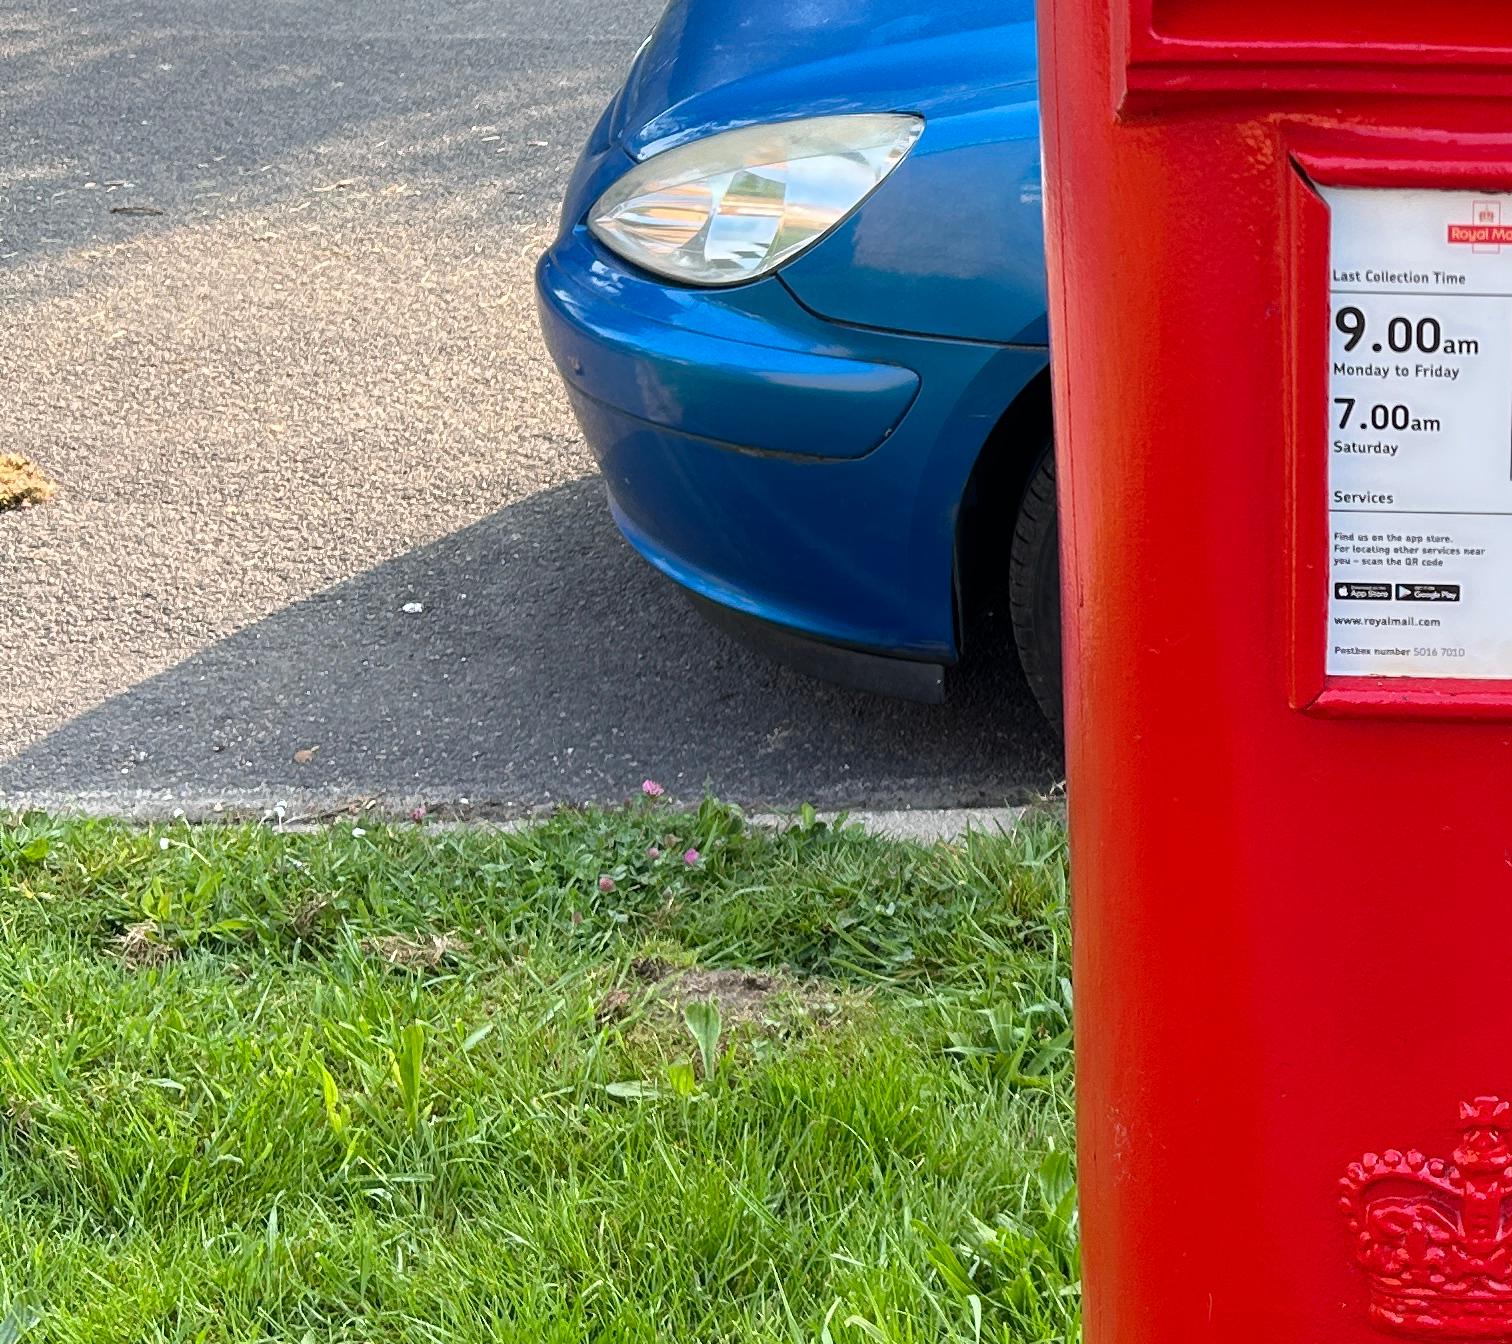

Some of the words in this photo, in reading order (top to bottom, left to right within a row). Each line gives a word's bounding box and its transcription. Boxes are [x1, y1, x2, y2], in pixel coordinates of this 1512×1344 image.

[1451, 226, 1490, 243] Royal
[1333, 269, 1361, 283] Last
[1365, 270, 1429, 284] Collection
[1433, 271, 1466, 286] Time
[1335, 307, 1479, 355] 9.00am
[1333, 363, 1390, 380] Monday
[1395, 365, 1409, 377] to
[1415, 364, 1460, 380] Friday
[1334, 398, 1441, 432] 7.00am
[1333, 439, 1399, 457] Saturday
[1334, 490, 1394, 504] Services
[1334, 532, 1354, 542] Find
[1357, 534, 1369, 542] us
[1371, 534, 1384, 542] on
[1386, 533, 1403, 542] the
[1405, 535, 1423, 544] app
[1334, 544, 1350, 553] For
[1352, 545, 1391, 556] locating
[1393, 545, 1420, 555] other
[1422, 546, 1461, 556] services
[1463, 548, 1486, 556] near
[1333, 558, 1351, 567] you
[1361, 558, 1384, 566] scan
[1386, 557, 1402, 566] the
[1405, 557, 1418, 567] QR
[1421, 558, 1444, 567] code
[1334, 616, 1441, 627] www.royalmail.com
[1334, 646, 1371, 655] Postbox
[1374, 647, 1411, 656] number
[1413, 647, 1438, 657] 5016
[1440, 647, 1465, 657] 7010
